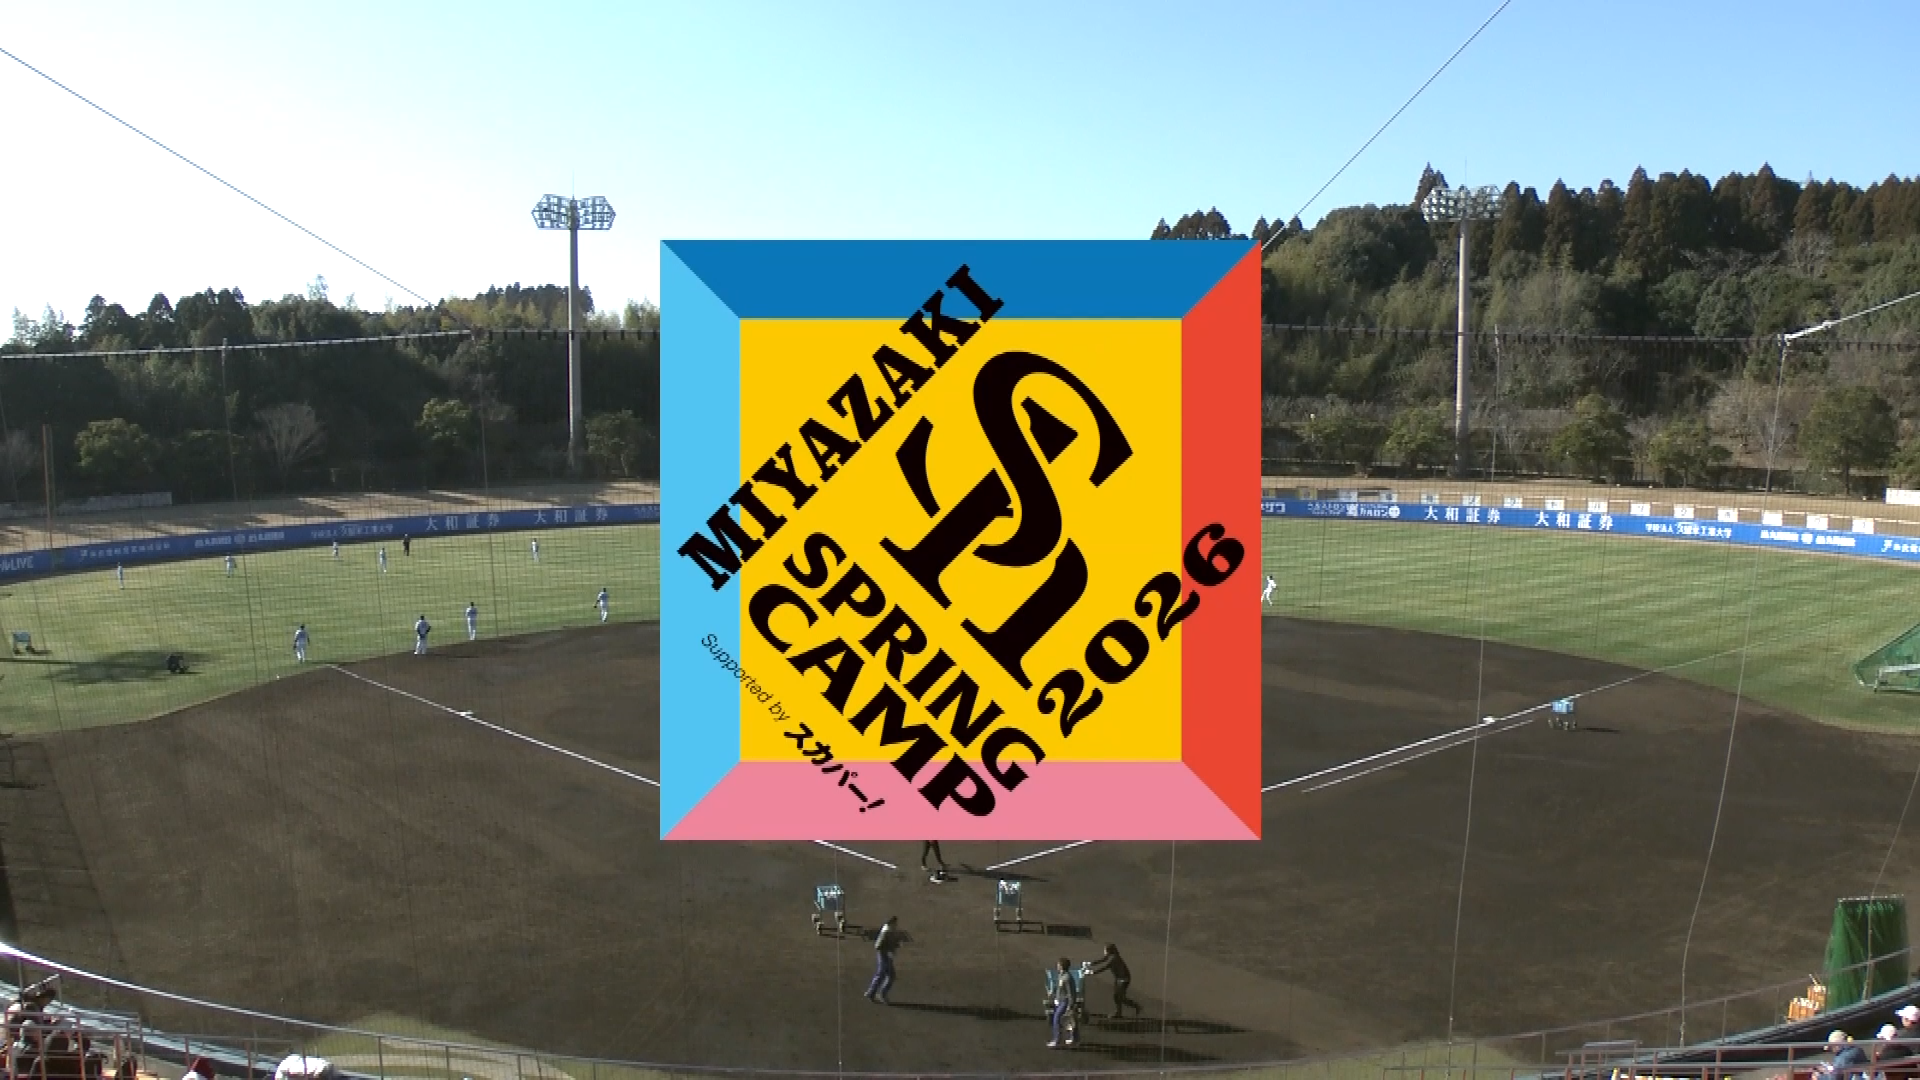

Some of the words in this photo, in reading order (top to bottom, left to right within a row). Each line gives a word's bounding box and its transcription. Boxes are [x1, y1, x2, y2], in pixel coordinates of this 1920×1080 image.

[425, 513, 500, 532] 大和証券
[534, 508, 609, 524] 大和証券
[1424, 506, 1501, 524] 大和証券
[1535, 513, 1614, 532] 大和証券
